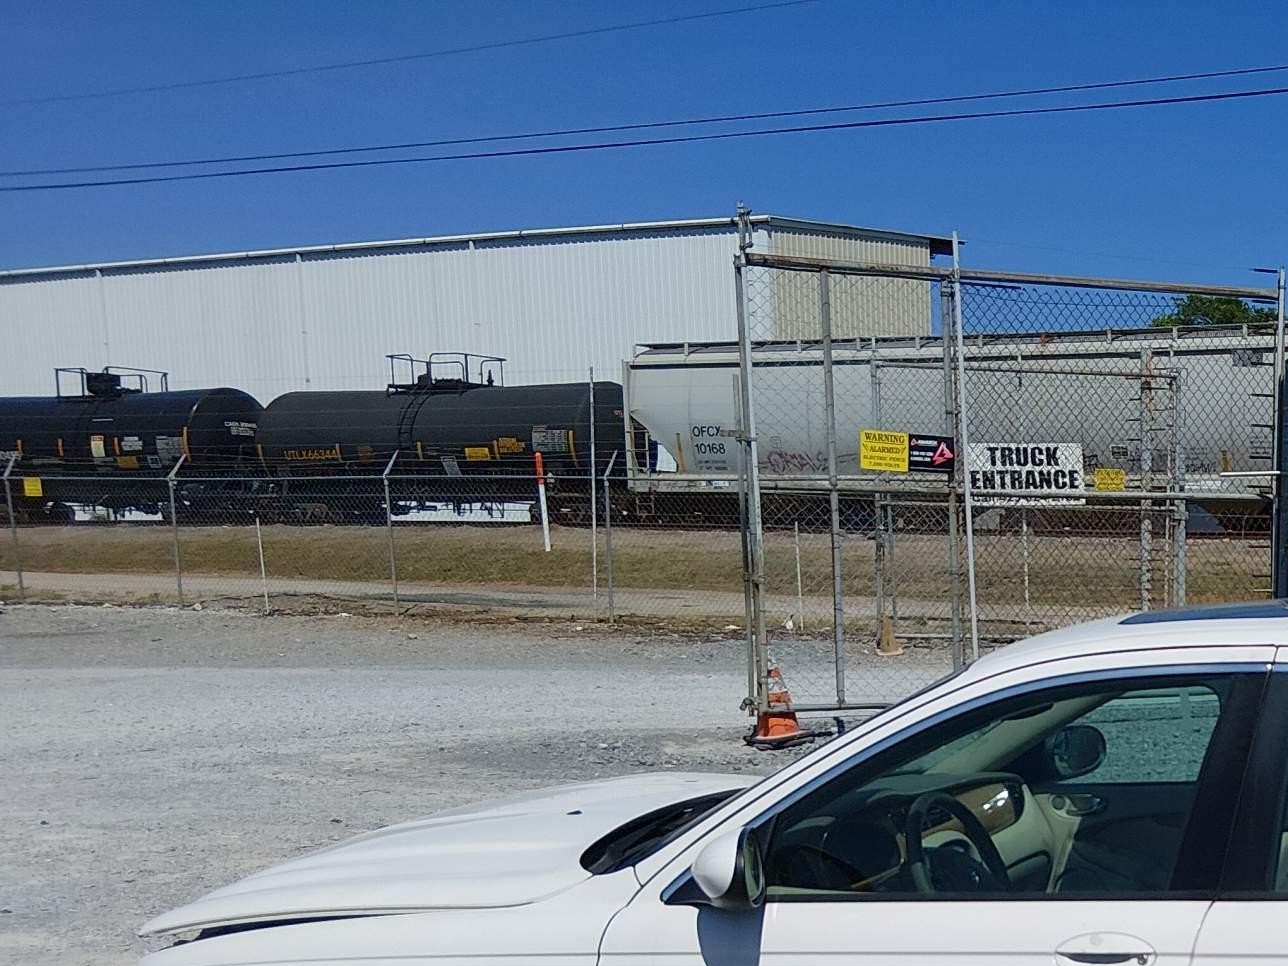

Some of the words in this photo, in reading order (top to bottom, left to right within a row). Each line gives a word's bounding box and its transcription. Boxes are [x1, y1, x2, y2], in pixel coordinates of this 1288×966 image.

[864, 432, 905, 444] WARNING
[694, 443, 726, 454] 10168
[869, 446, 900, 454] ALARMED
[986, 446, 1060, 467] TRUCK
[970, 470, 1080, 490] ENTRANCE
